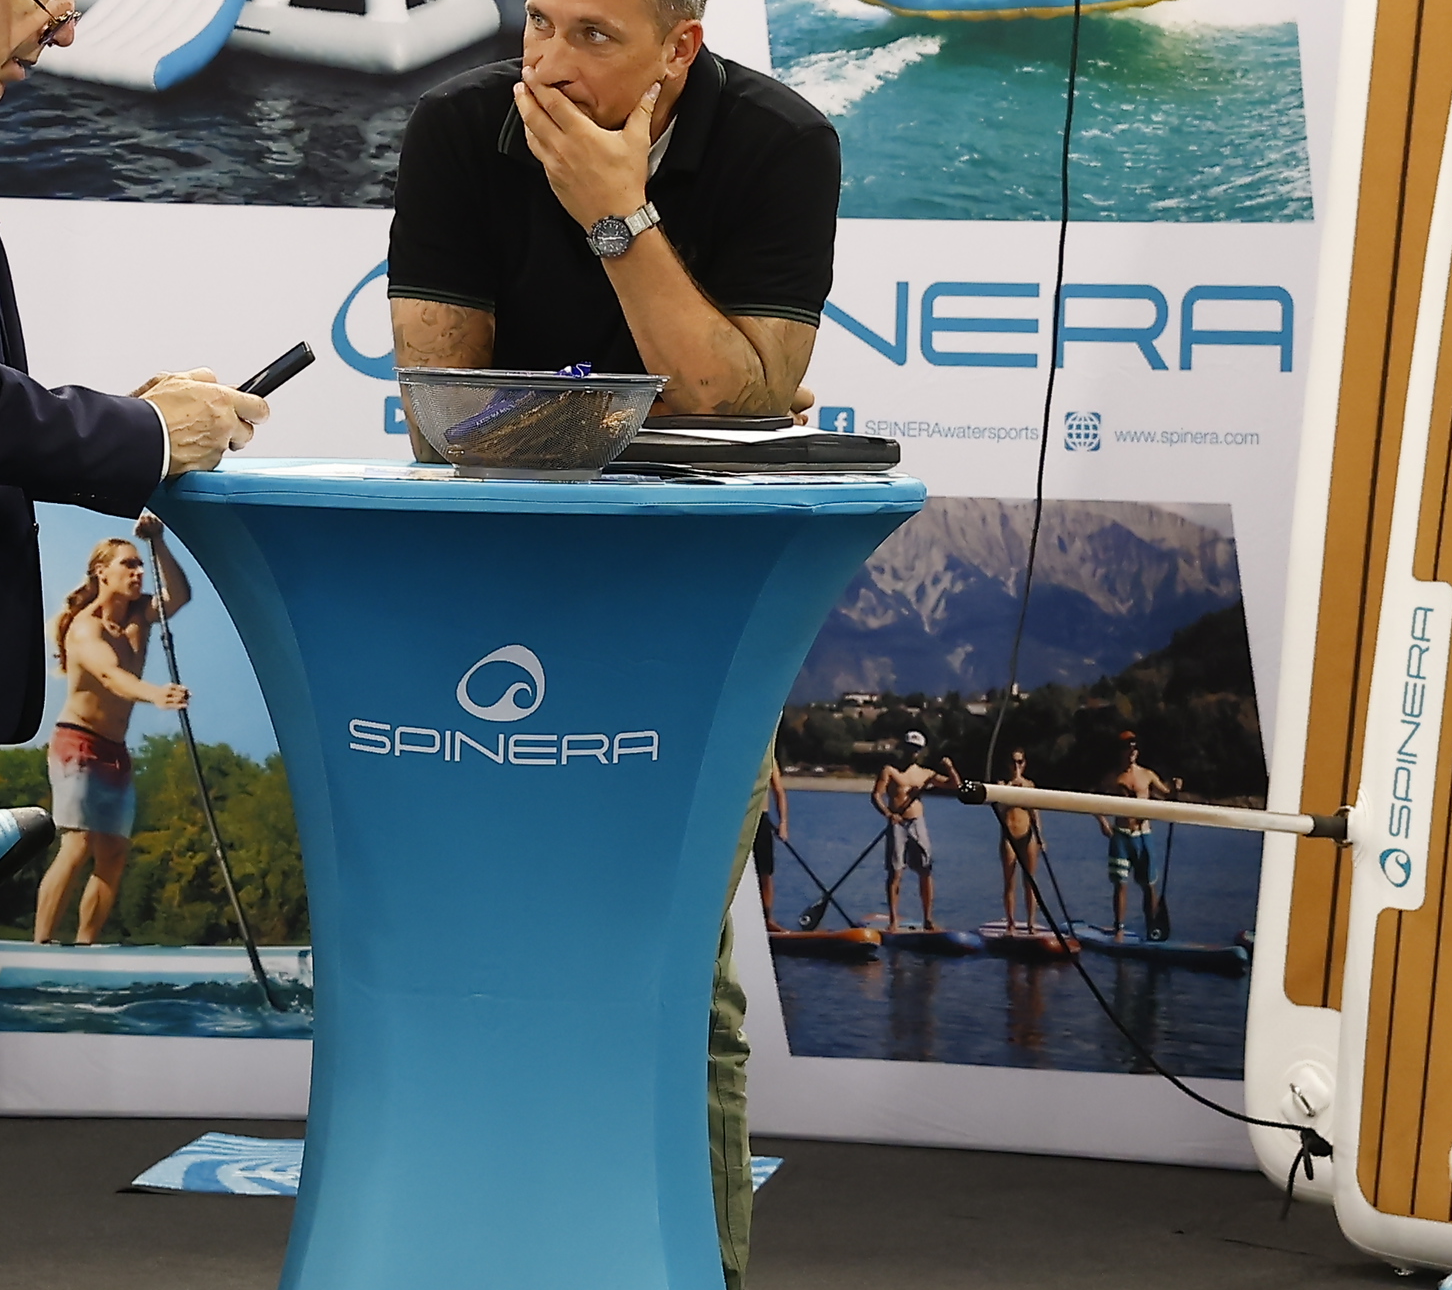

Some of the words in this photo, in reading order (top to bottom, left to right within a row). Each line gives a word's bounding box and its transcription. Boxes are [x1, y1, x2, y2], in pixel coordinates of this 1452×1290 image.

[822, 280, 1294, 373] NERA
[864, 420, 1040, 444] SPINERAwatersports
[1114, 426, 1261, 447] www.spinera.com
[348, 717, 660, 766] SPINERA
[1388, 605, 1434, 839] SPINERA
